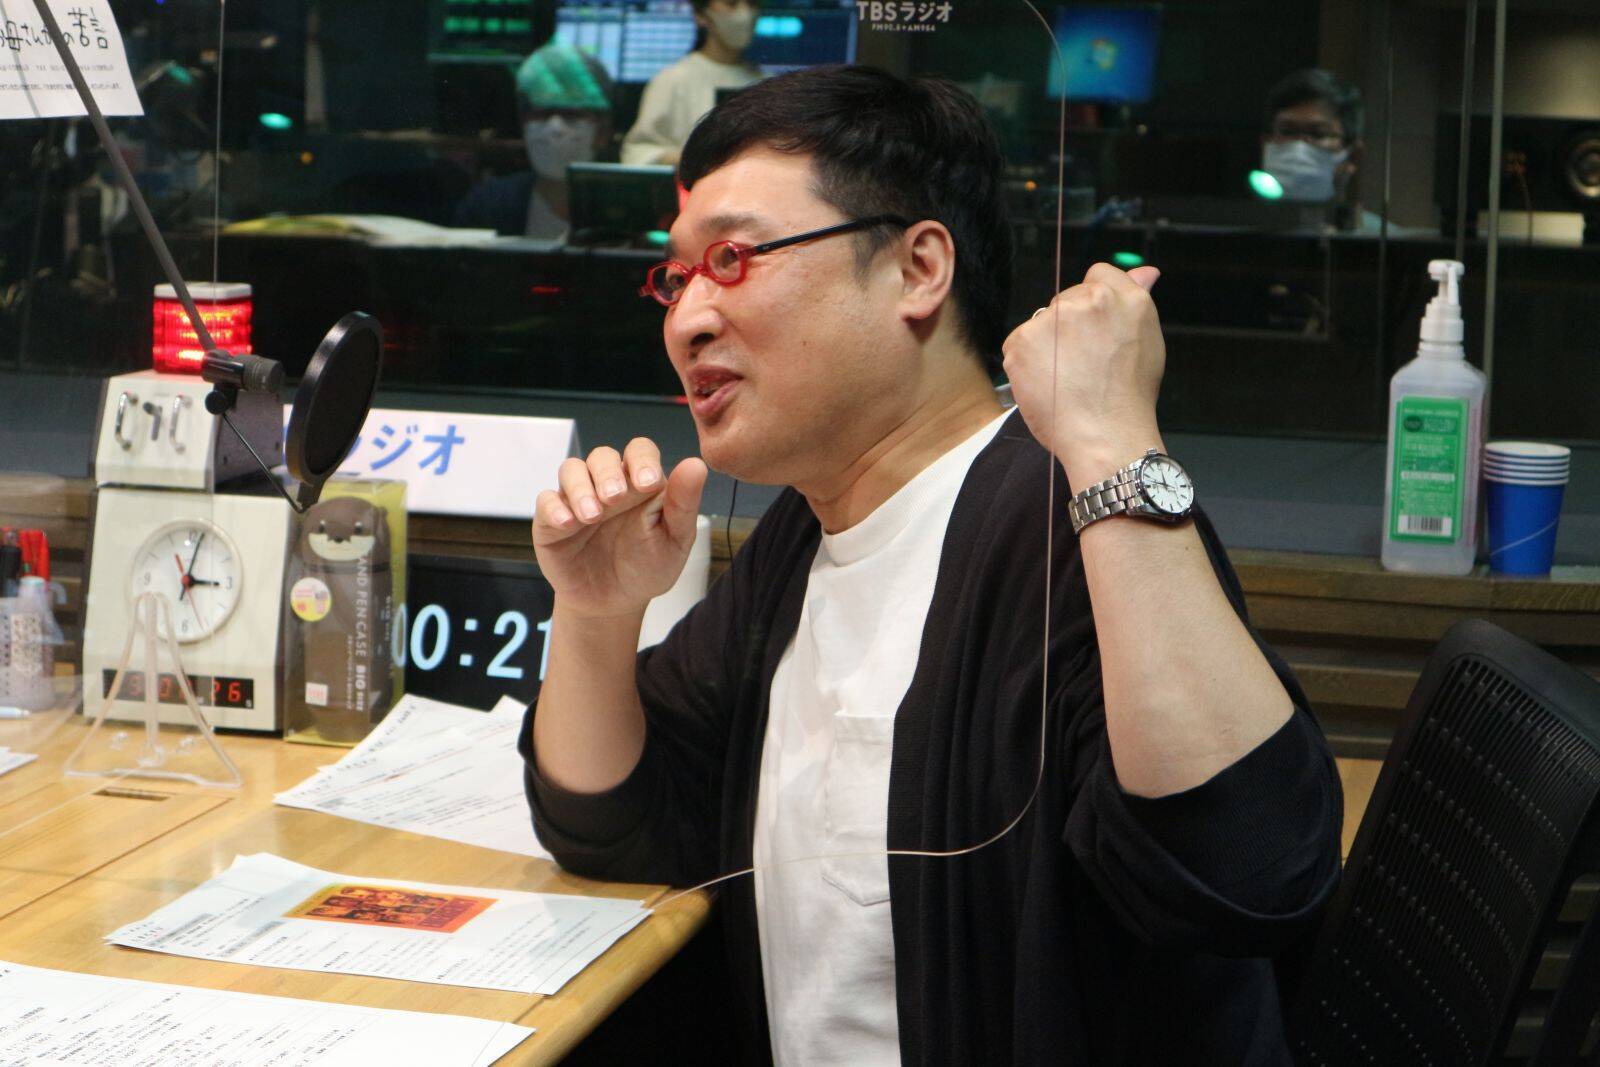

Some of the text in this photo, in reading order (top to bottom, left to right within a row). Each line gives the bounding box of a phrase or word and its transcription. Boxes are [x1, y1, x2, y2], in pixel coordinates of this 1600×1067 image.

[856, 1, 953, 23] TBSラジオ
[355, 591, 368, 618] PEN
[355, 621, 367, 656] CASE
[355, 664, 367, 690] BIG
